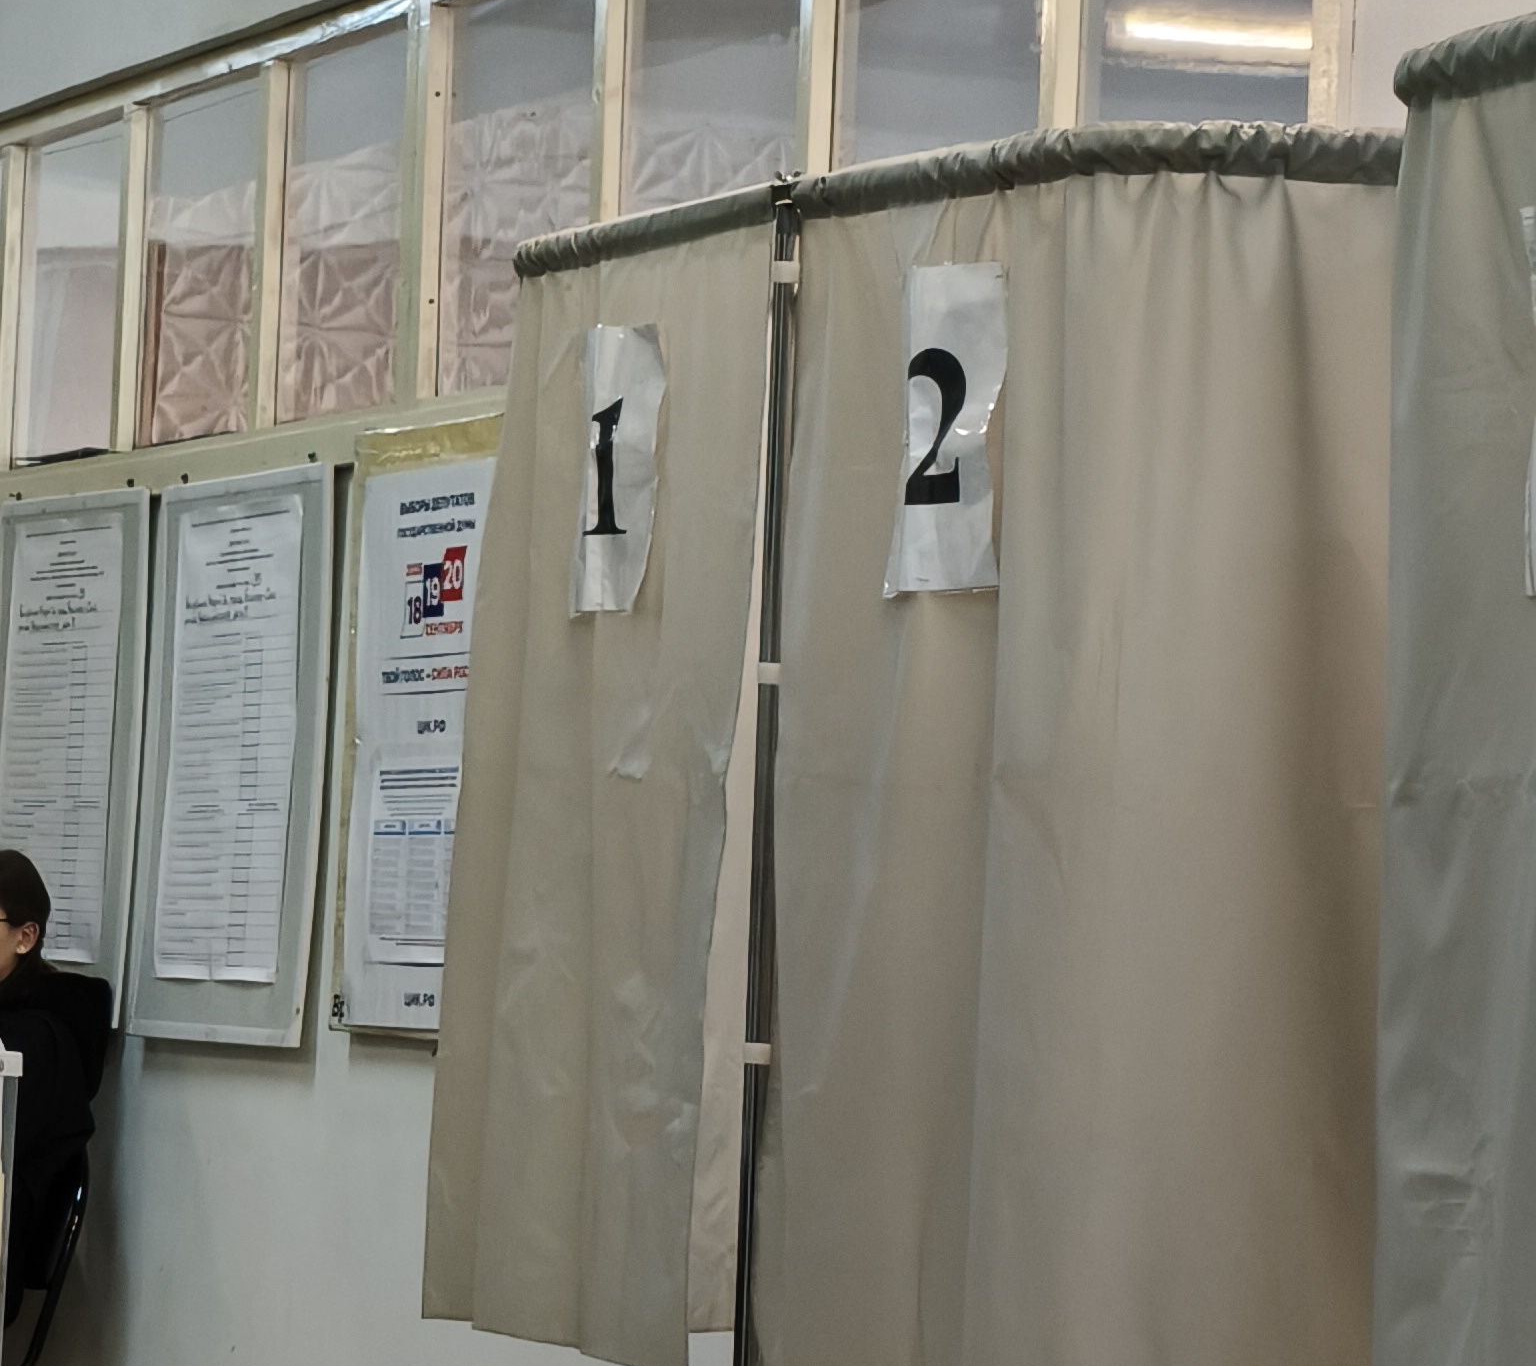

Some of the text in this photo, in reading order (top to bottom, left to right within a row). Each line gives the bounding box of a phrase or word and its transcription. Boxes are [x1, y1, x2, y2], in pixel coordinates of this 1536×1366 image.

[903, 347, 968, 507] 2
[581, 396, 628, 537] 1
[444, 559, 463, 590] 20
[425, 576, 440, 606] 19
[407, 595, 422, 625] 18
